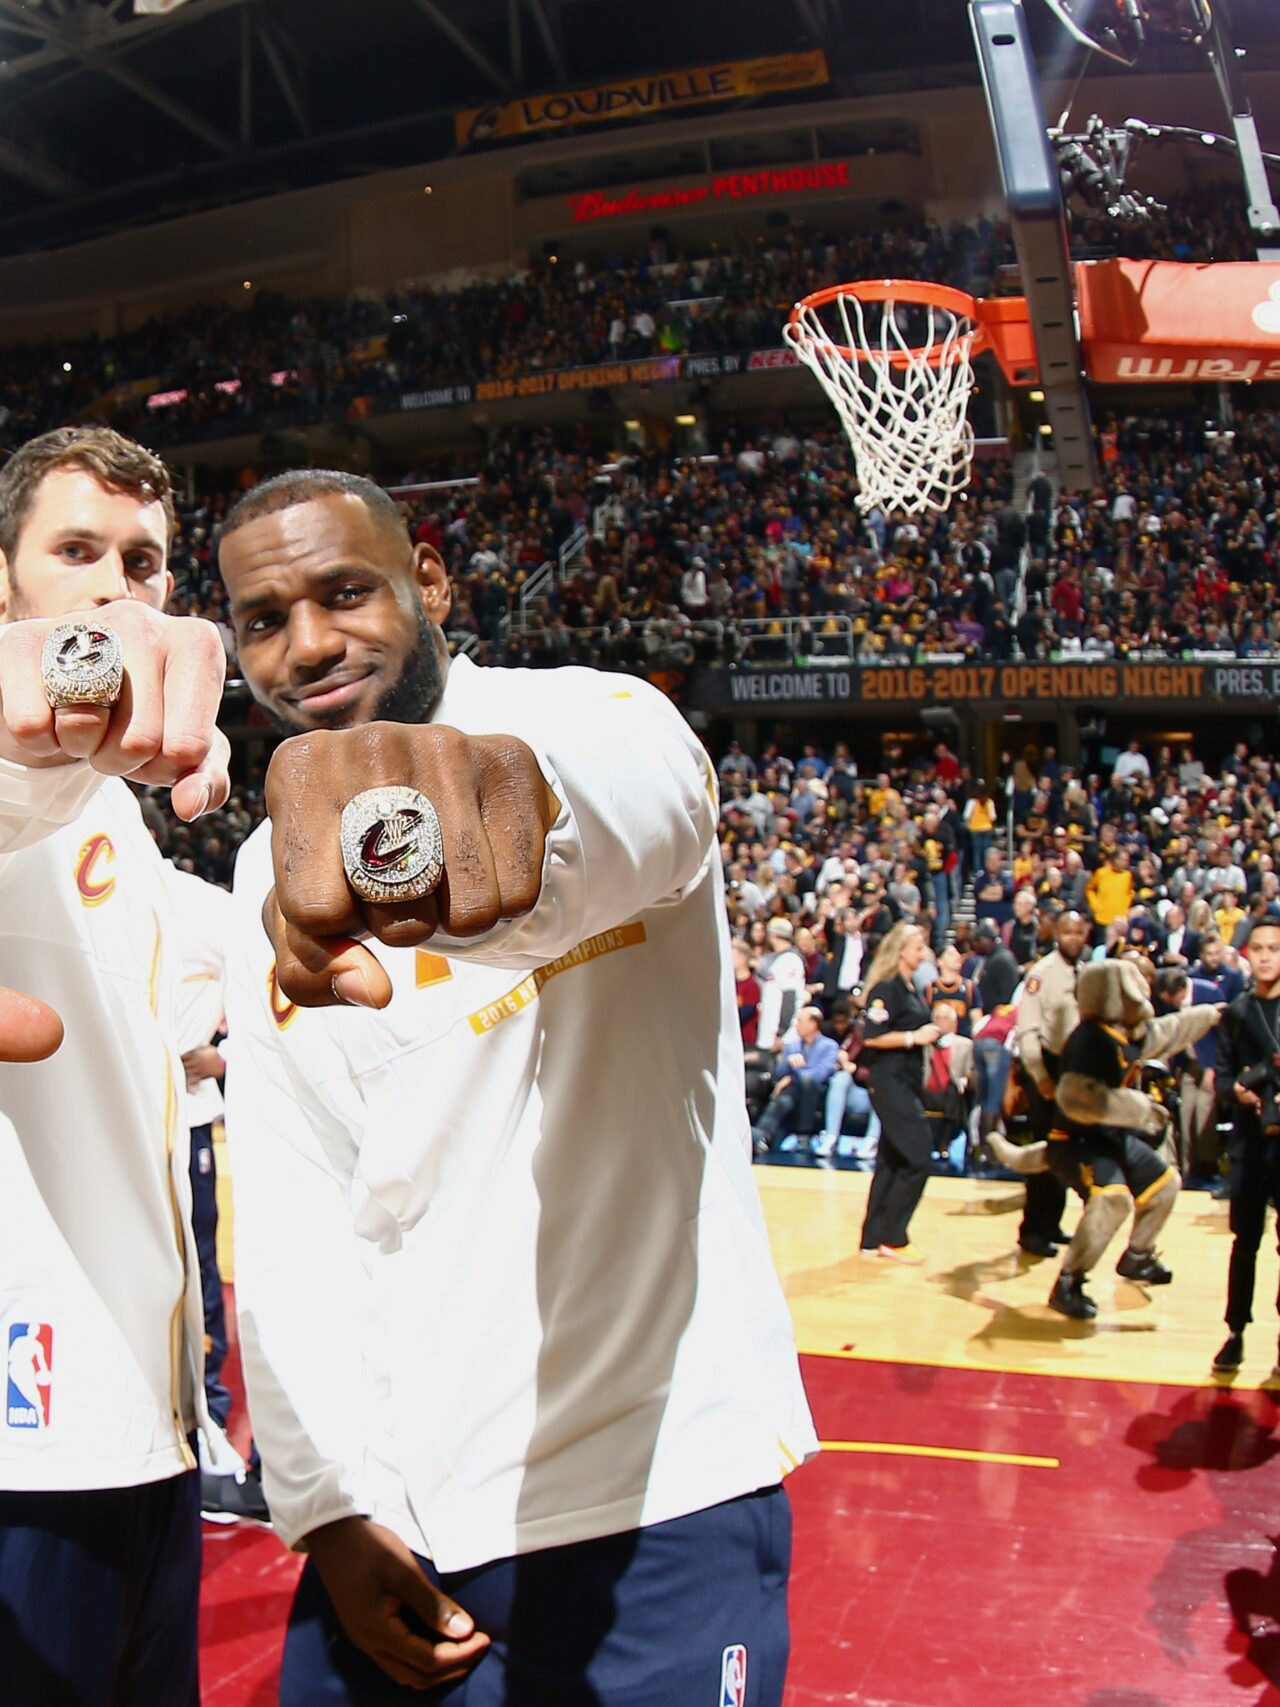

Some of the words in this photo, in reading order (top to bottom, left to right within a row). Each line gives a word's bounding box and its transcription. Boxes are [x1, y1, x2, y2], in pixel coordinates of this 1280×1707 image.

[522, 68, 736, 126] LOUDVILLE
[567, 184, 709, 221] Budweiser
[713, 162, 851, 199] PENTHOUSE
[400, 387, 452, 408] WELCOME
[455, 385, 470, 402] TO
[476, 375, 557, 400] 2016-2017
[558, 365, 628, 389] OPENING
[631, 357, 682, 382] NIGHT
[731, 674, 822, 700] WELCOME
[826, 672, 851, 698] TO
[861, 667, 995, 699] 2016-2017
[1001, 666, 1118, 698] OPENING
[1123, 666, 1205, 697] NIGHT
[478, 997, 518, 1030] 2016
[543, 928, 625, 977] CHAMPIONS
[9, 1406, 37, 1424] NBA
